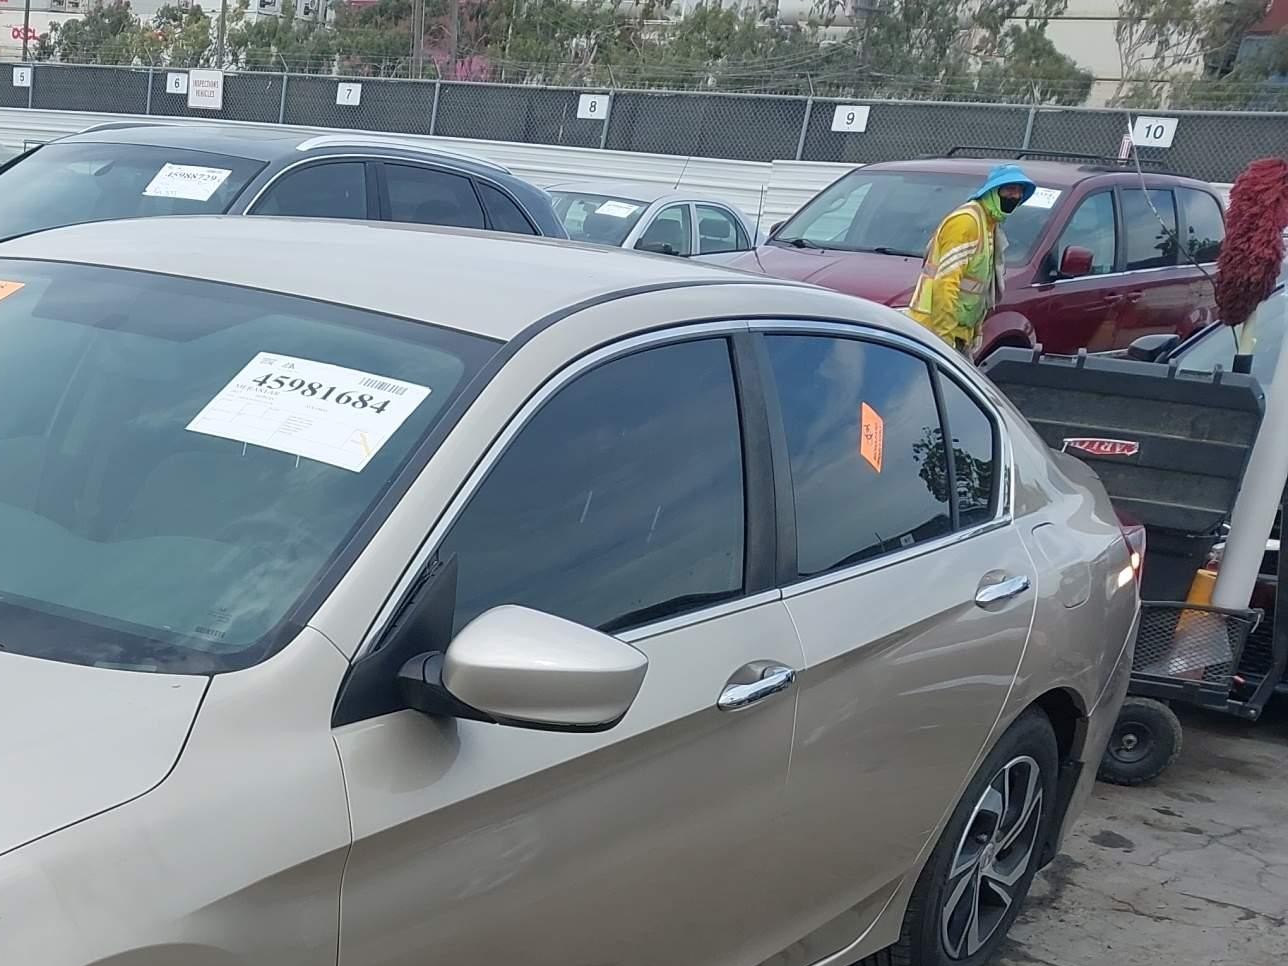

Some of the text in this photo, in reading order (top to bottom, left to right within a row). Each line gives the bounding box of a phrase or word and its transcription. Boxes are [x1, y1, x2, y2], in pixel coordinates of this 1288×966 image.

[19, 72, 25, 82] 5
[174, 78, 180, 88] 6
[345, 88, 352, 99] 7
[589, 101, 597, 113] 8
[846, 112, 855, 125] 9
[1144, 124, 1164, 139] 10
[252, 373, 391, 414] 45981684
